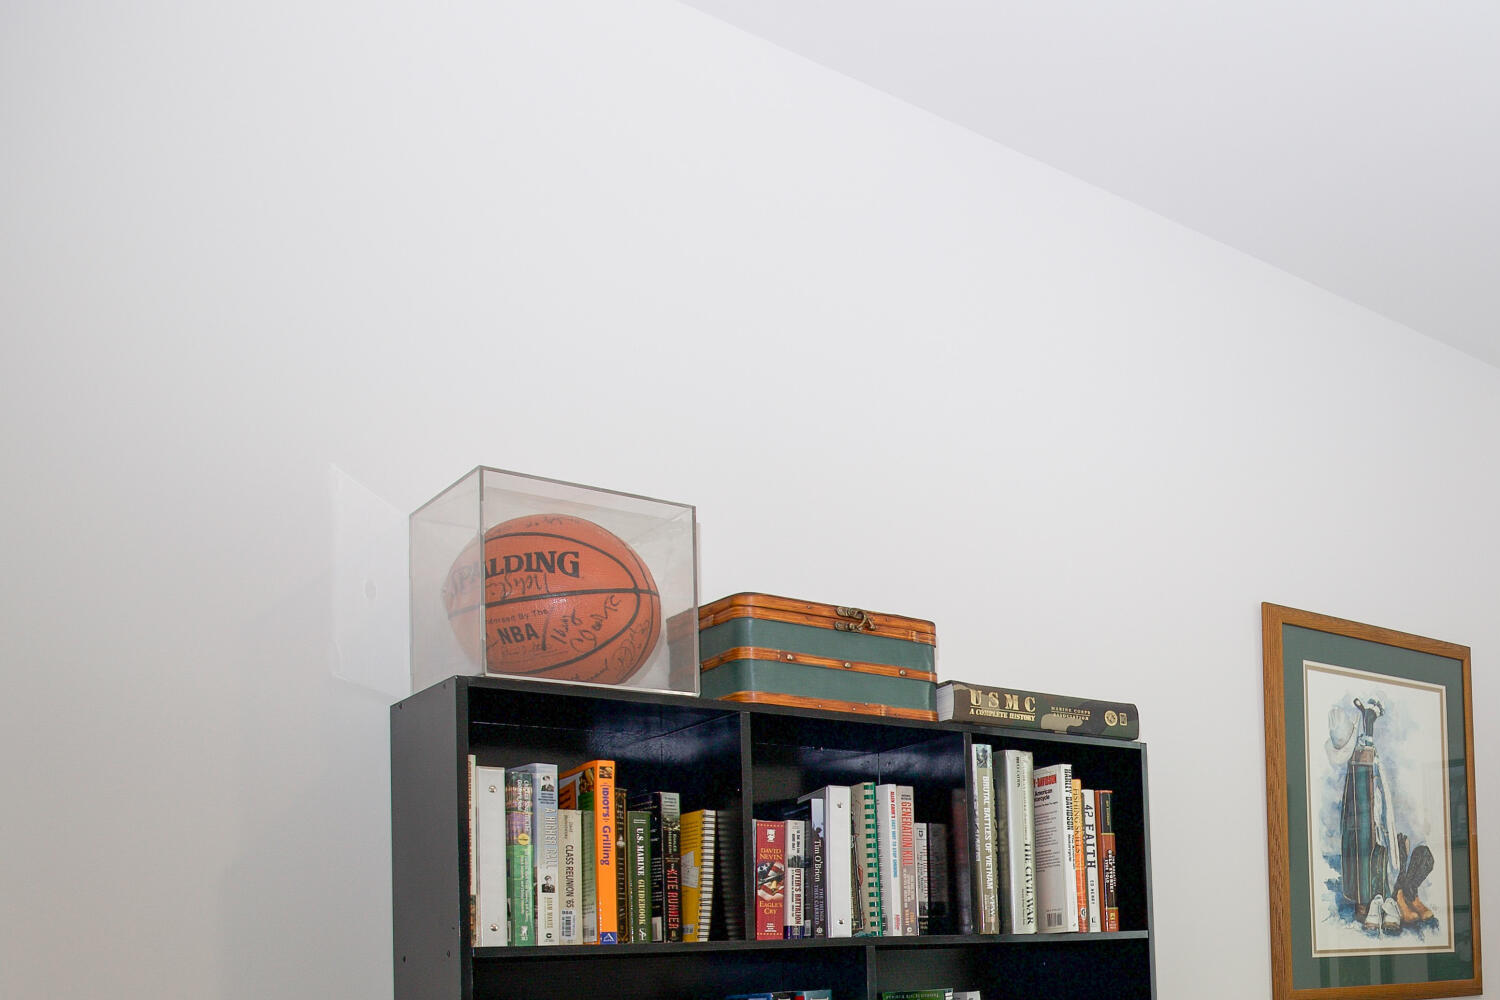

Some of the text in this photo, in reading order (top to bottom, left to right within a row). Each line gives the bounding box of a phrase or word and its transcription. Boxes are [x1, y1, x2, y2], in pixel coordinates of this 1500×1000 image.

[497, 622, 539, 645] NBA
[969, 707, 1036, 722] A COMPLETE HISTORY
[1072, 788, 1080, 823] FISHING
[901, 801, 913, 850] GENERATION
[982, 775, 993, 890] BRUTAL BATTLES OF VIETNAM
[1084, 804, 1097, 869] 42 FAITH
[565, 844, 575, 866] CLASS
[600, 825, 611, 867] Grilling
[814, 839, 822, 883] Tim O'Brien
[902, 850, 913, 866] KILL
[1024, 842, 1032, 864] THE
[564, 866, 576, 897] REUNION
[636, 827, 646, 926] U.S. MARINE GUIDEBOOK
[1024, 865, 1034, 896] CIVIL
[667, 869, 680, 930] KITE RUNNER
[794, 893, 803, 925] BATTALION
[1026, 898, 1034, 925] WAR
